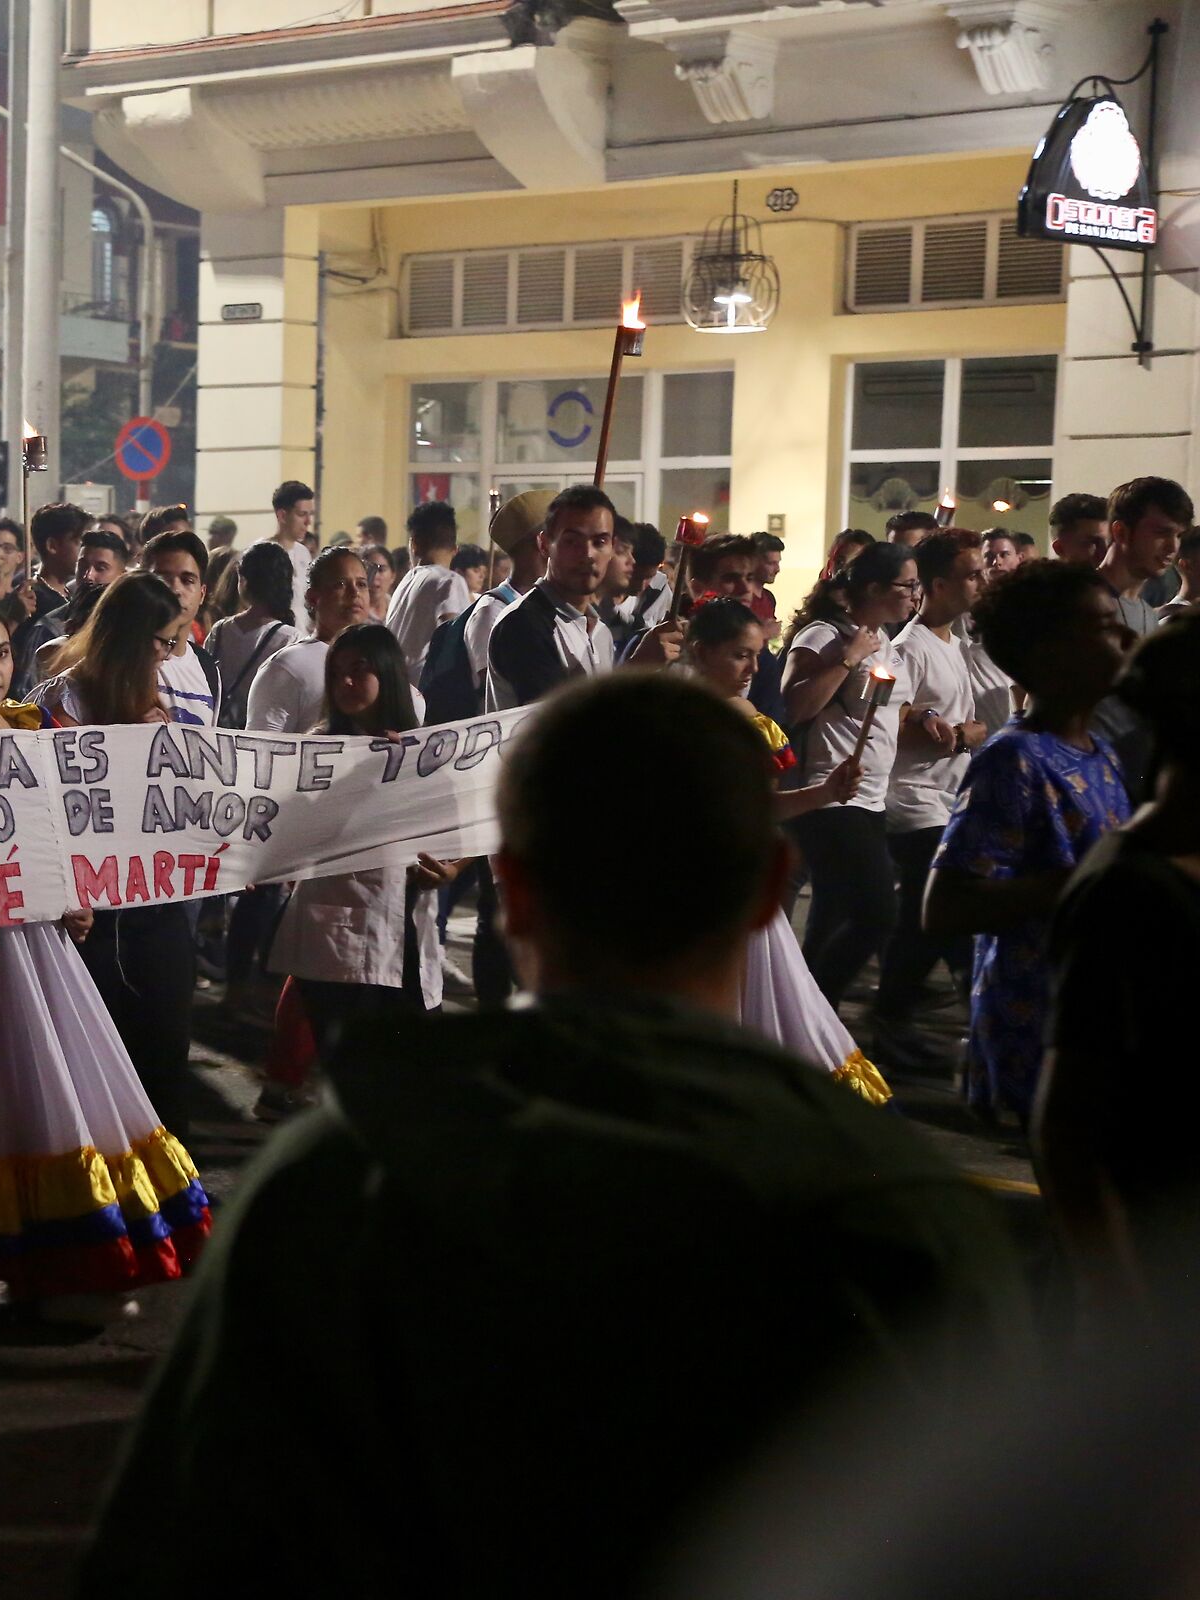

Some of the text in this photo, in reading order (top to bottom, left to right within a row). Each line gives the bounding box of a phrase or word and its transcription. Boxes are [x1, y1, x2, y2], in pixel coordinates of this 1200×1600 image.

[53, 730, 108, 785] ES
[146, 725, 345, 792] ANTE
[63, 788, 114, 836] DE
[141, 784, 279, 842] AMOR
[70, 843, 231, 909] MARTÍ
